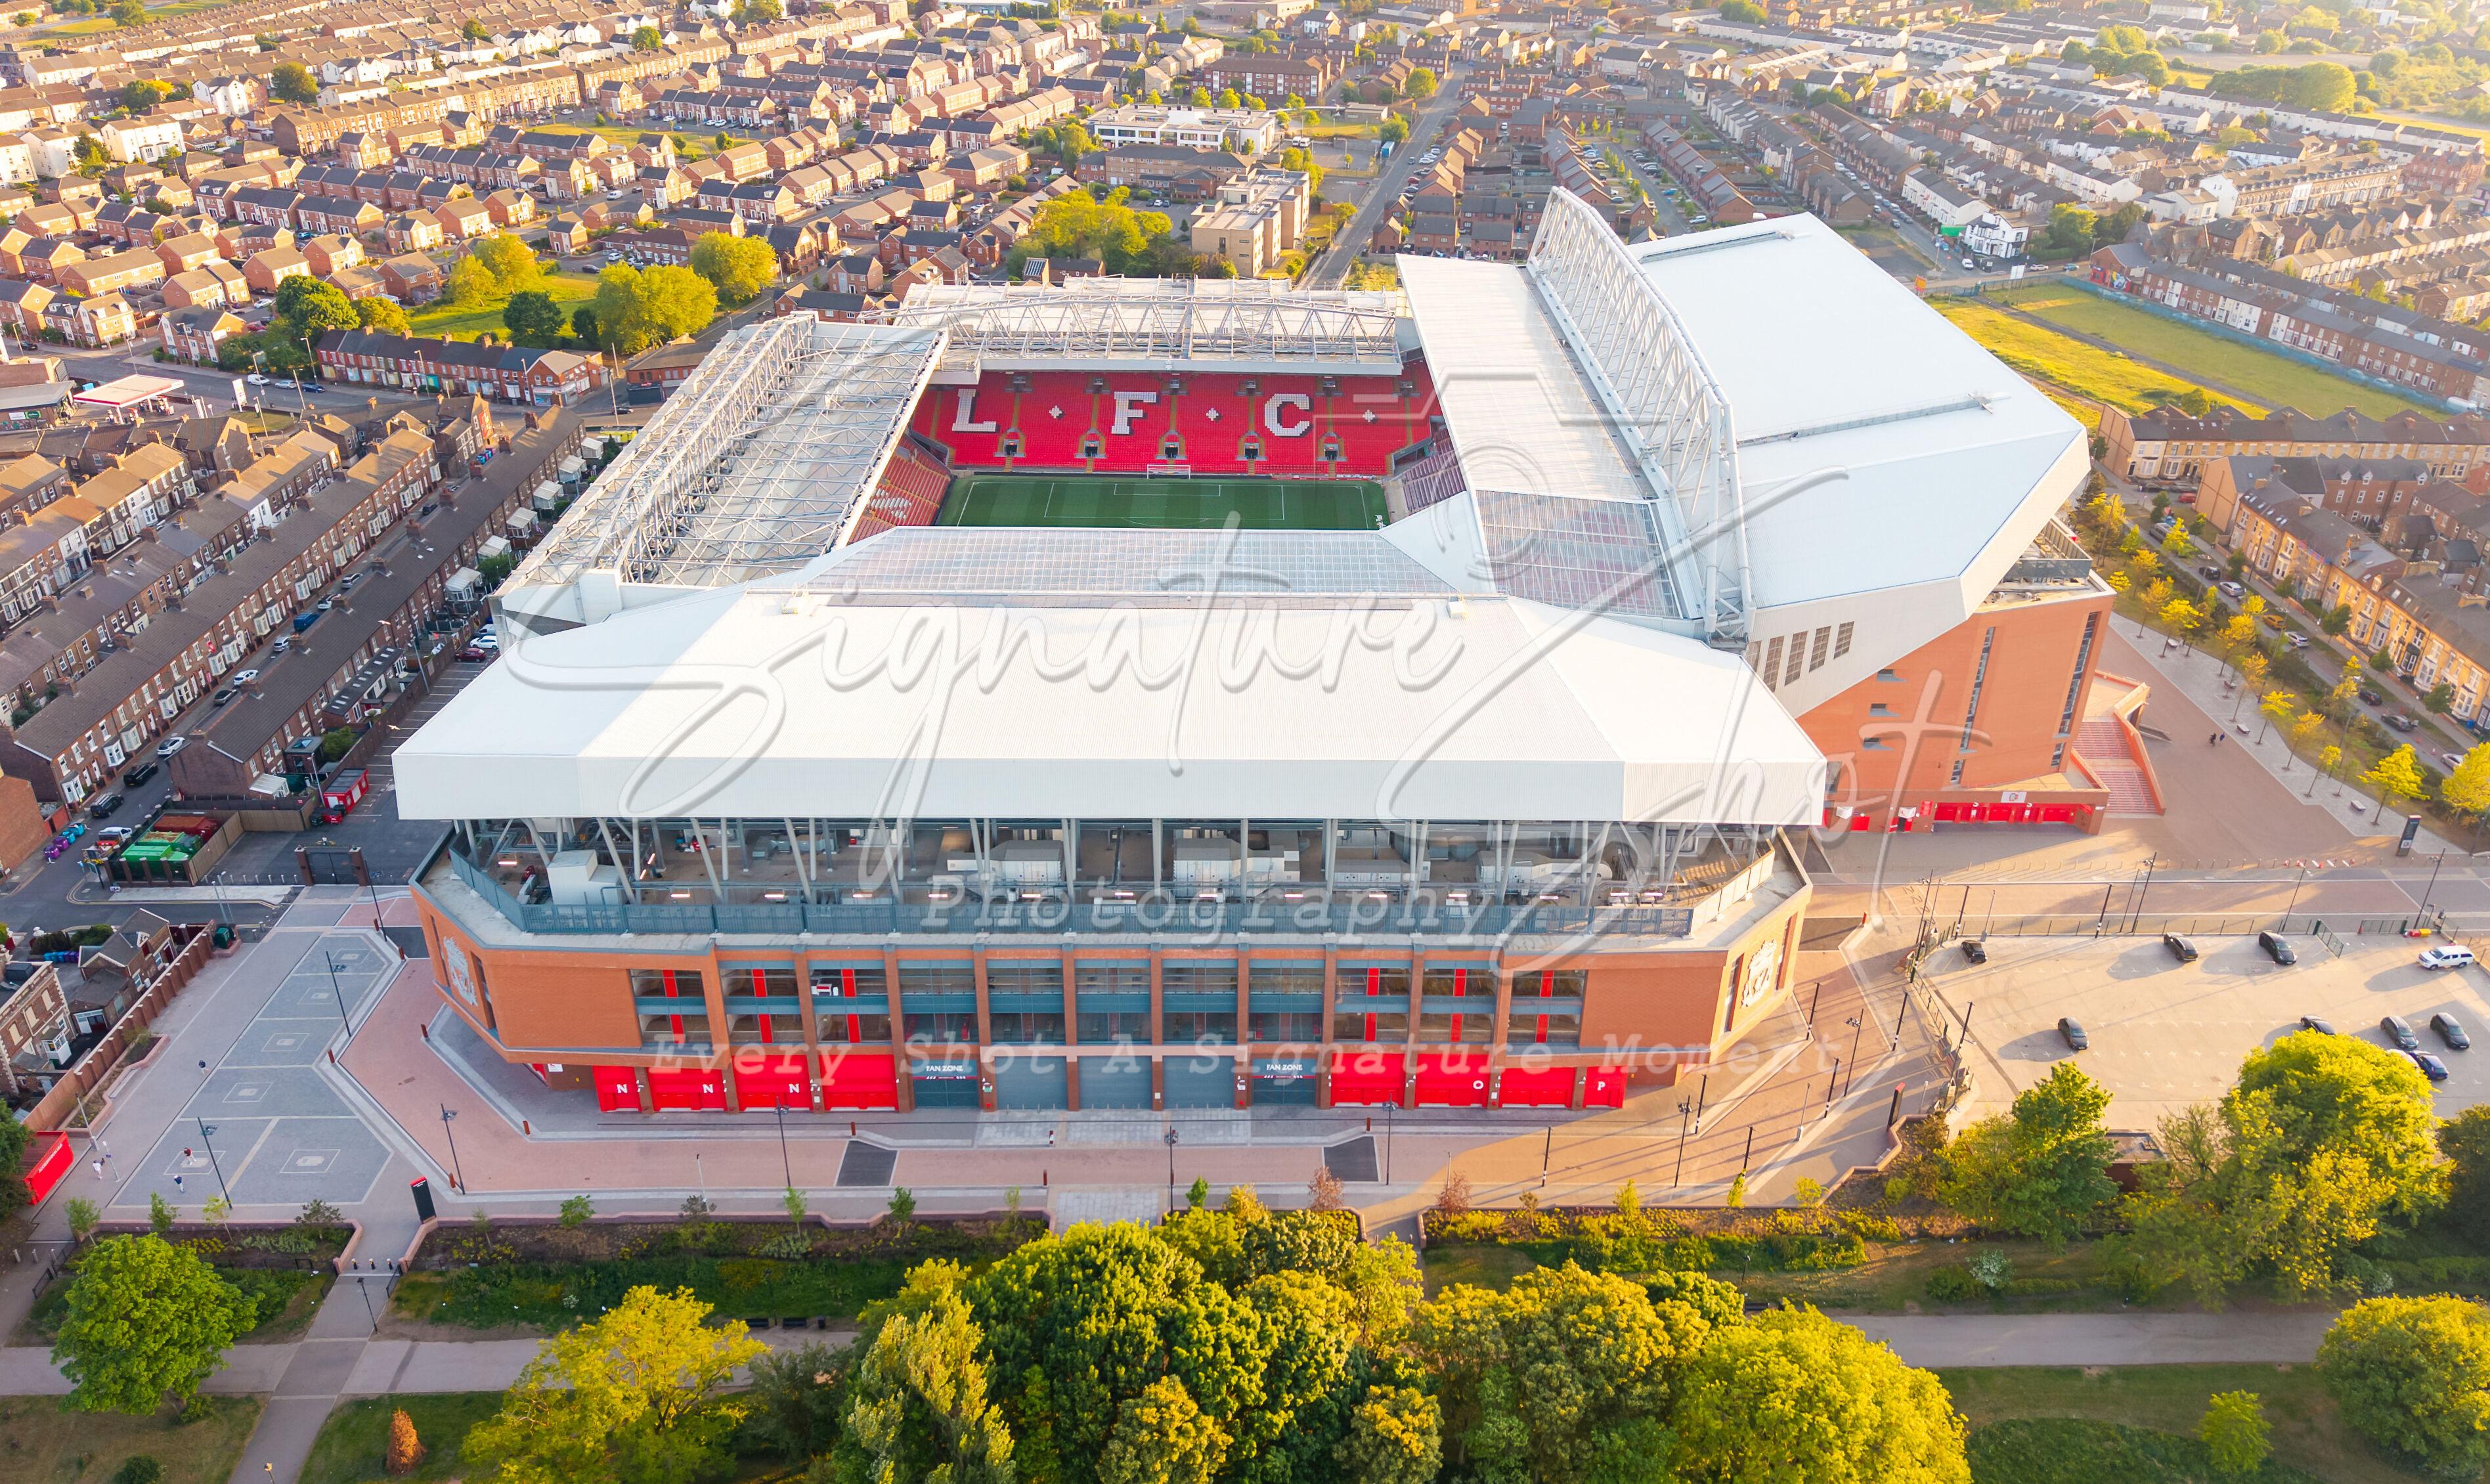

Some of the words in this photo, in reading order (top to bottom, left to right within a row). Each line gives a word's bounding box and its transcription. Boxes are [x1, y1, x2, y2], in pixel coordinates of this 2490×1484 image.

[952, 389, 996, 432] L
[1111, 391, 1156, 435] F
[1264, 394, 1309, 436] C
[617, 1084, 628, 1093] N
[703, 1083, 714, 1093] N
[789, 1083, 800, 1093] N
[1473, 1080, 1484, 1090] O
[1598, 1081, 1605, 1091] P
